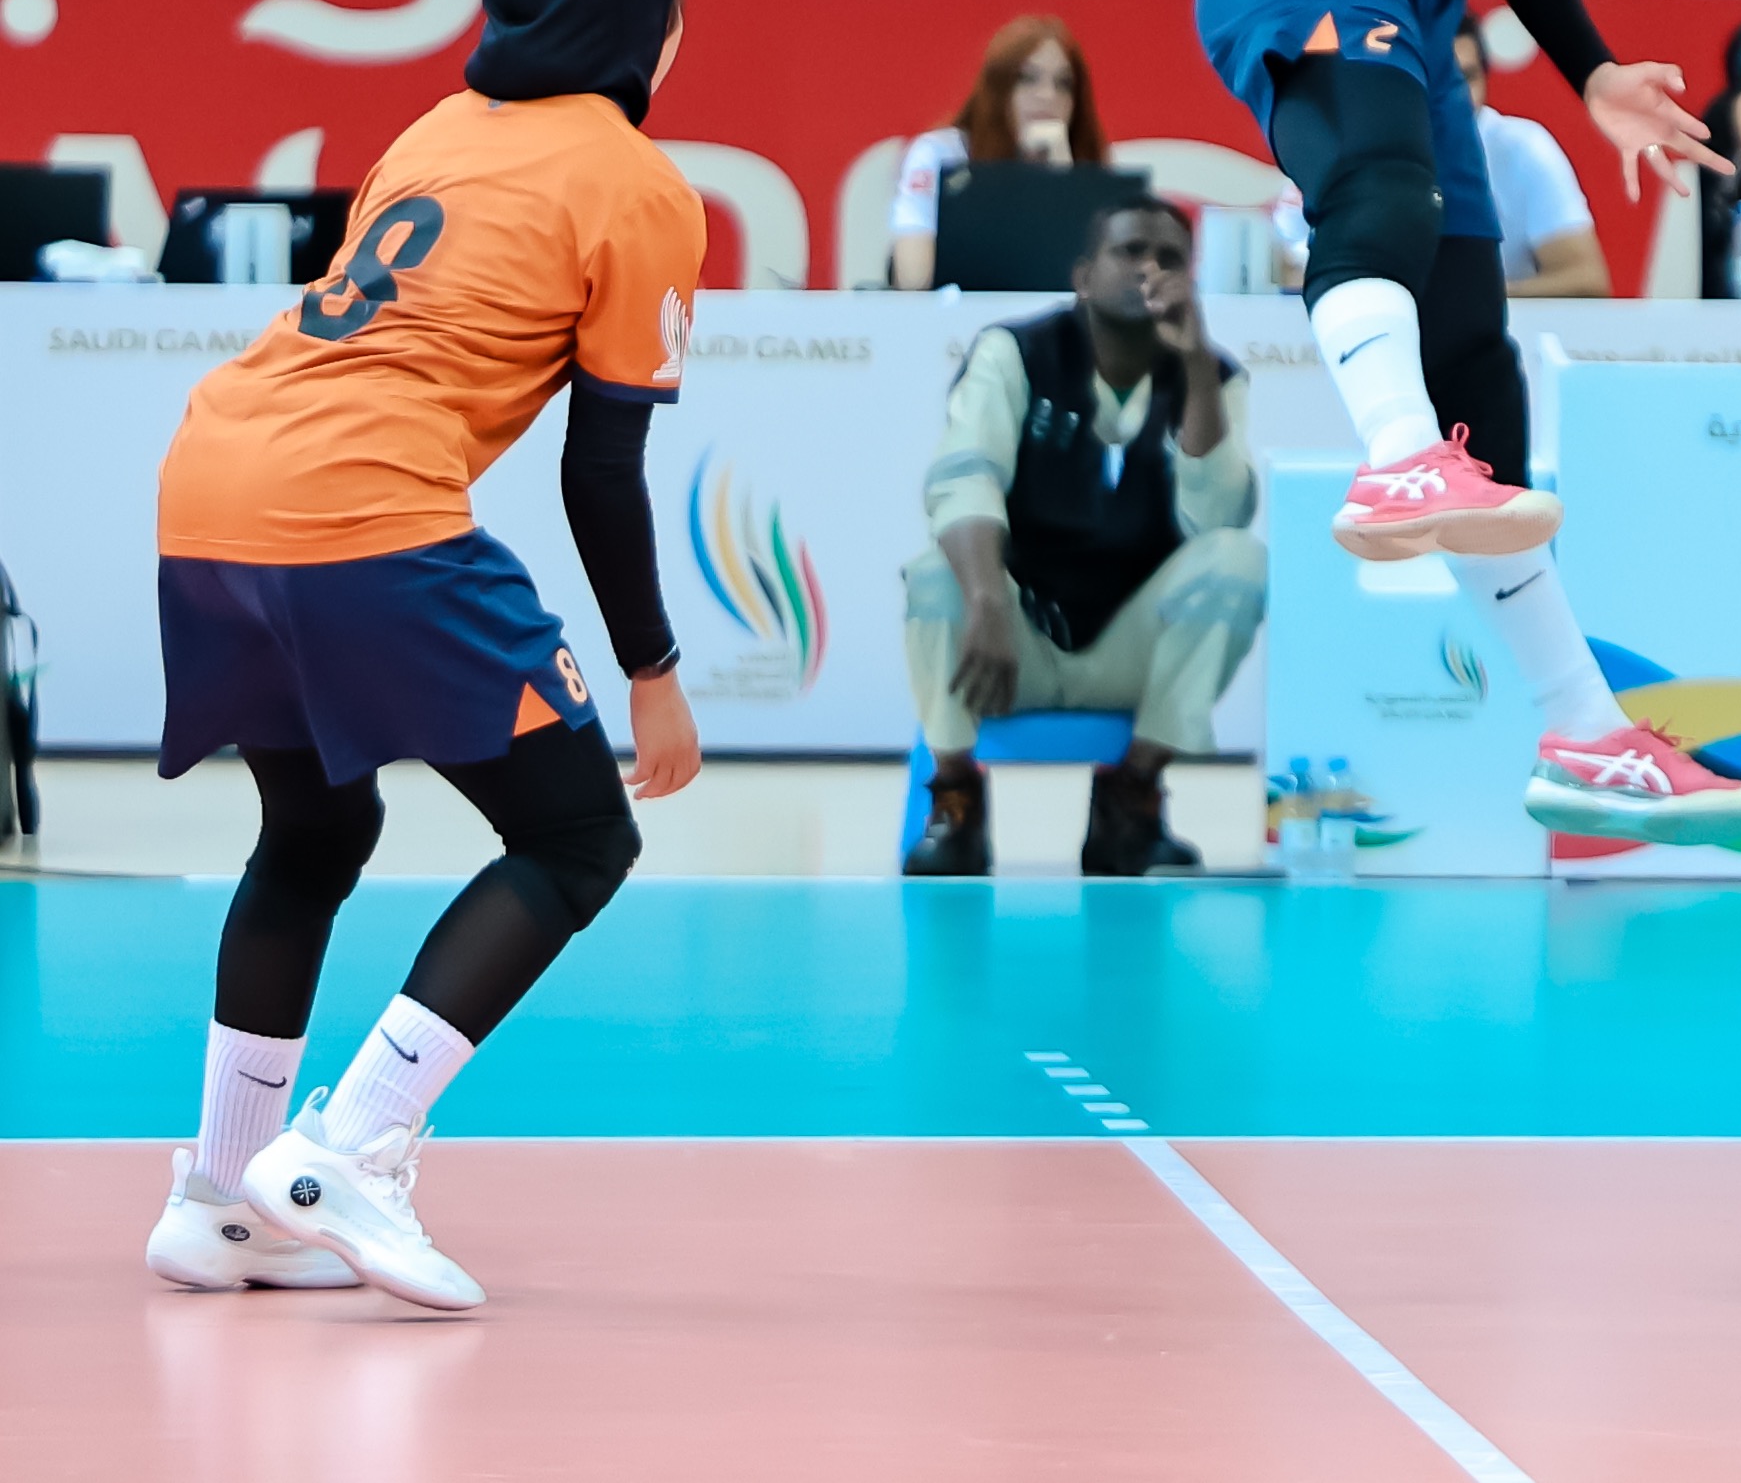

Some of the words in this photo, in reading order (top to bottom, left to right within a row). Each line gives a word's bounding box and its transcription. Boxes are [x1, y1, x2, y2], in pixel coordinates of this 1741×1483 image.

[298, 196, 444, 341] 8
[49, 327, 147, 351] SAUDI
[155, 327, 263, 351] GAME
[757, 336, 872, 361] GAMES
[556, 647, 588, 703] 8
